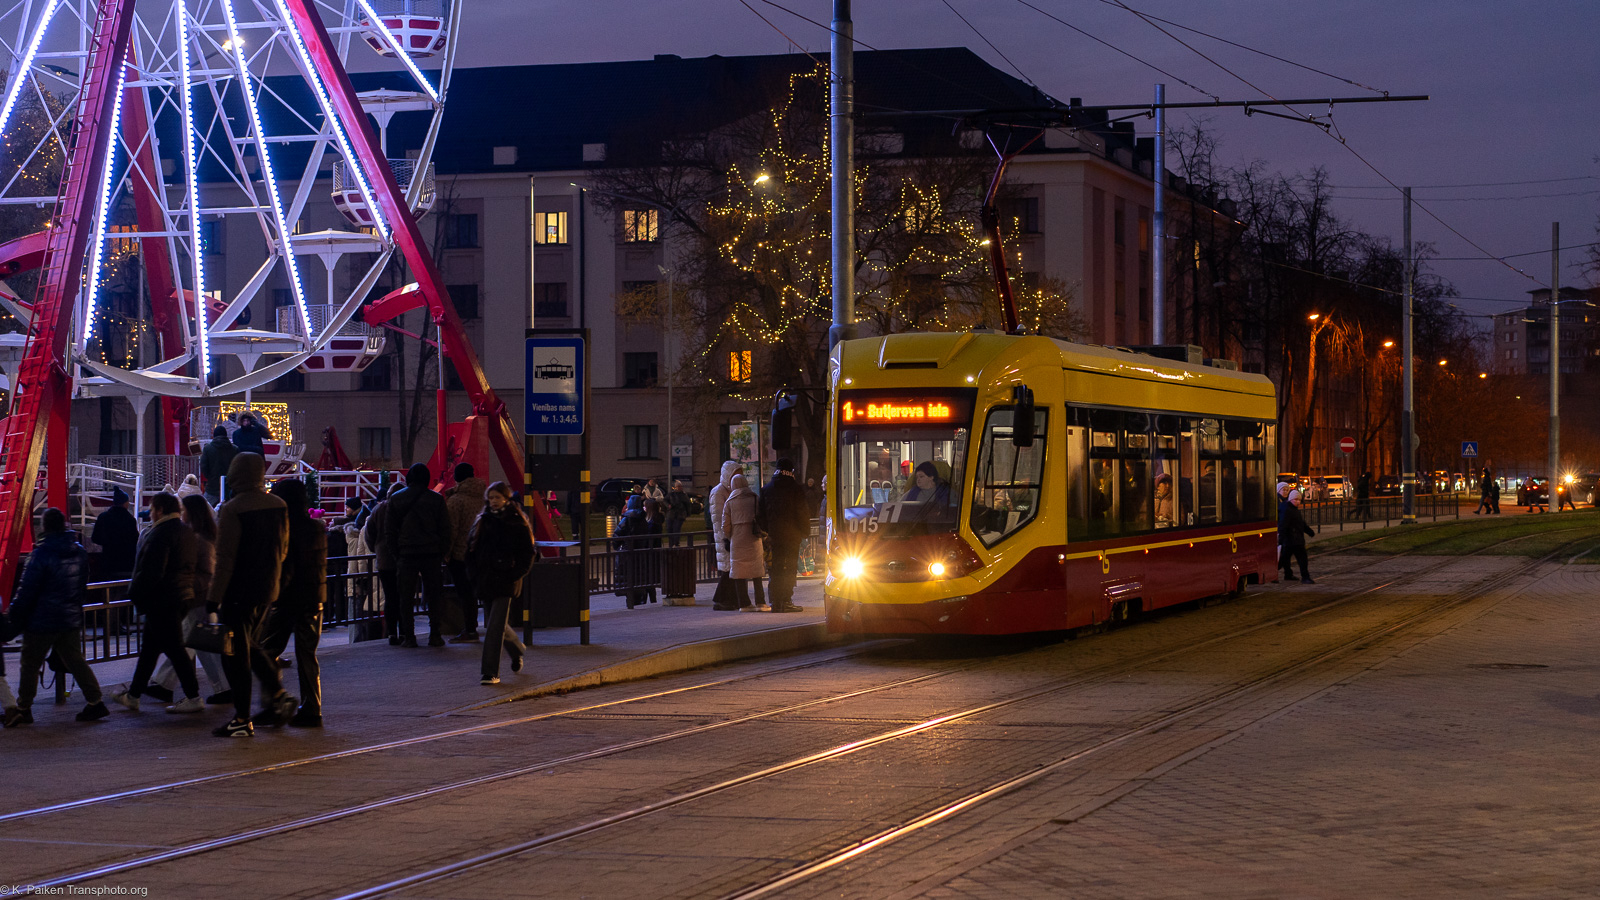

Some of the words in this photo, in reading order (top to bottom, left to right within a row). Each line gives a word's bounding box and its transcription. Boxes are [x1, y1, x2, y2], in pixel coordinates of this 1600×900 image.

[843, 401, 853, 420] 1
[927, 403, 949, 417] iela
[541, 415, 551, 423] Nr.
[849, 517, 878, 533] 015
